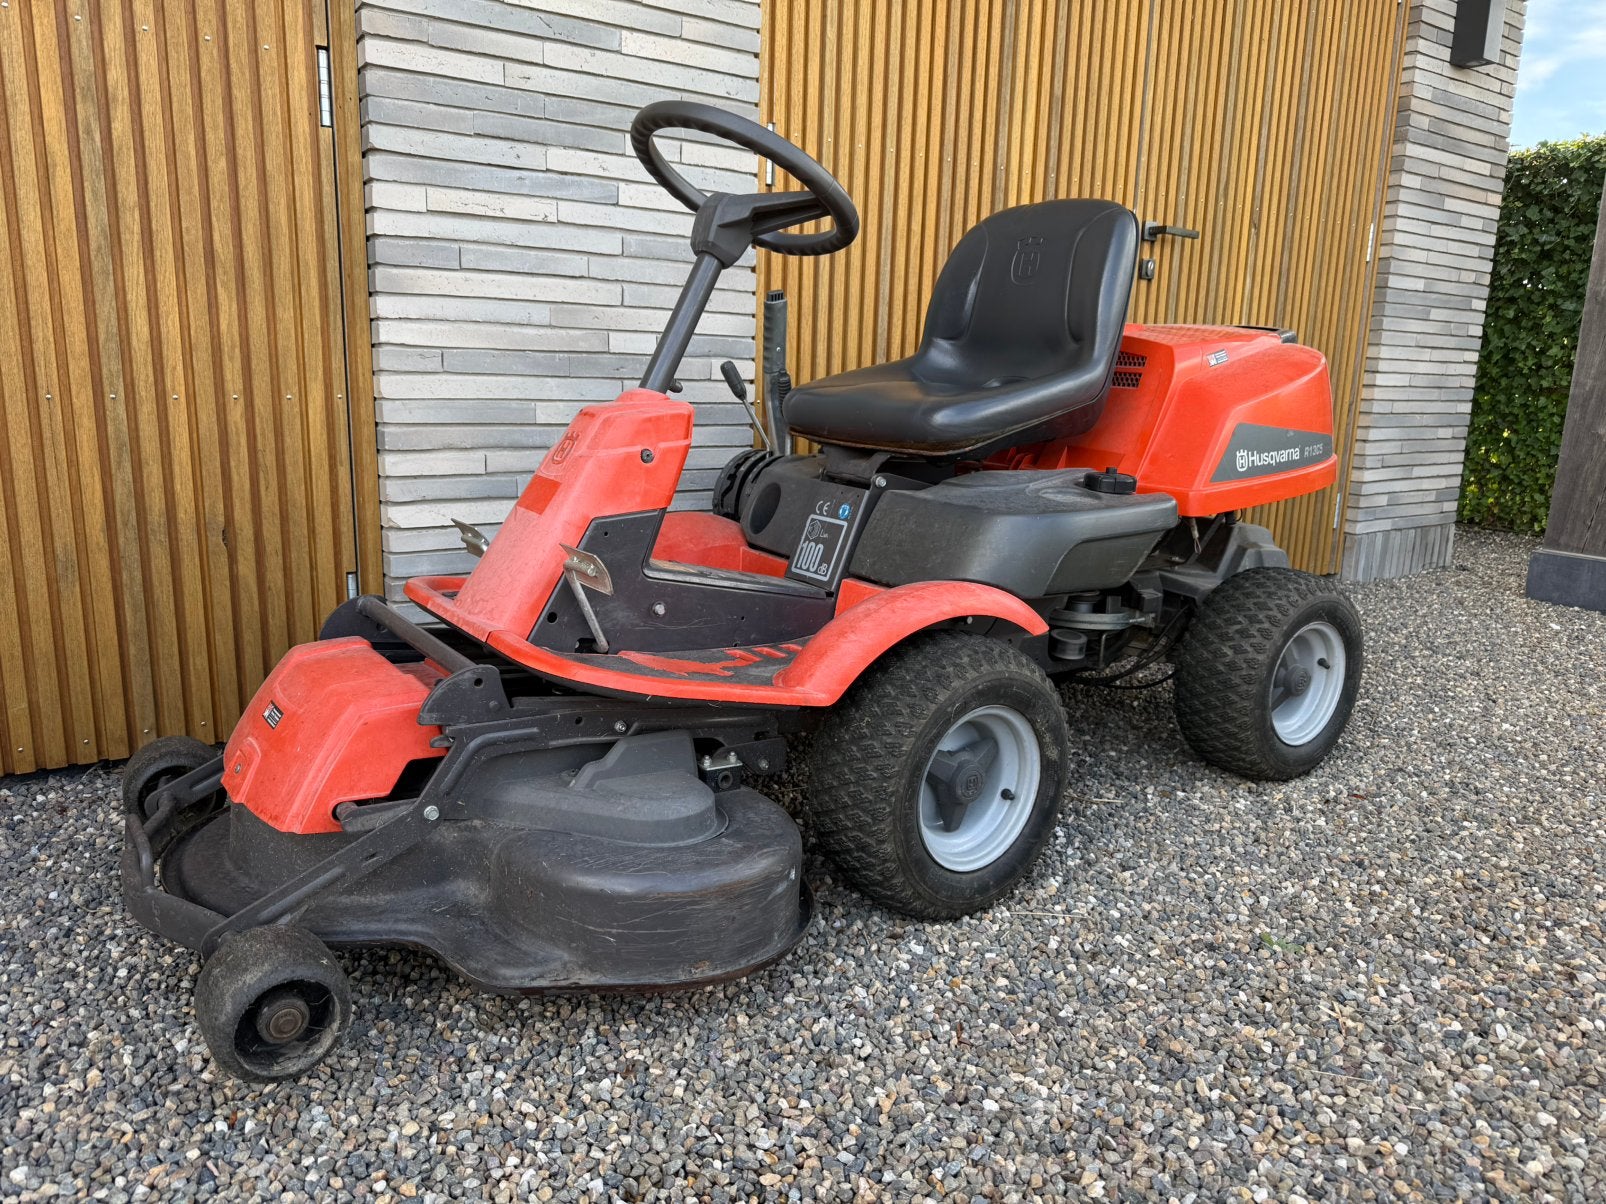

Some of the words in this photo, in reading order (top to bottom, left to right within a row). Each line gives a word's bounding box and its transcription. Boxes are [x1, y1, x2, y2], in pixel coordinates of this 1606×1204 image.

[1248, 446, 1300, 467] Husqvarna
[815, 500, 830, 515] CE
[796, 540, 824, 572] 100
[817, 563, 828, 575] dB
